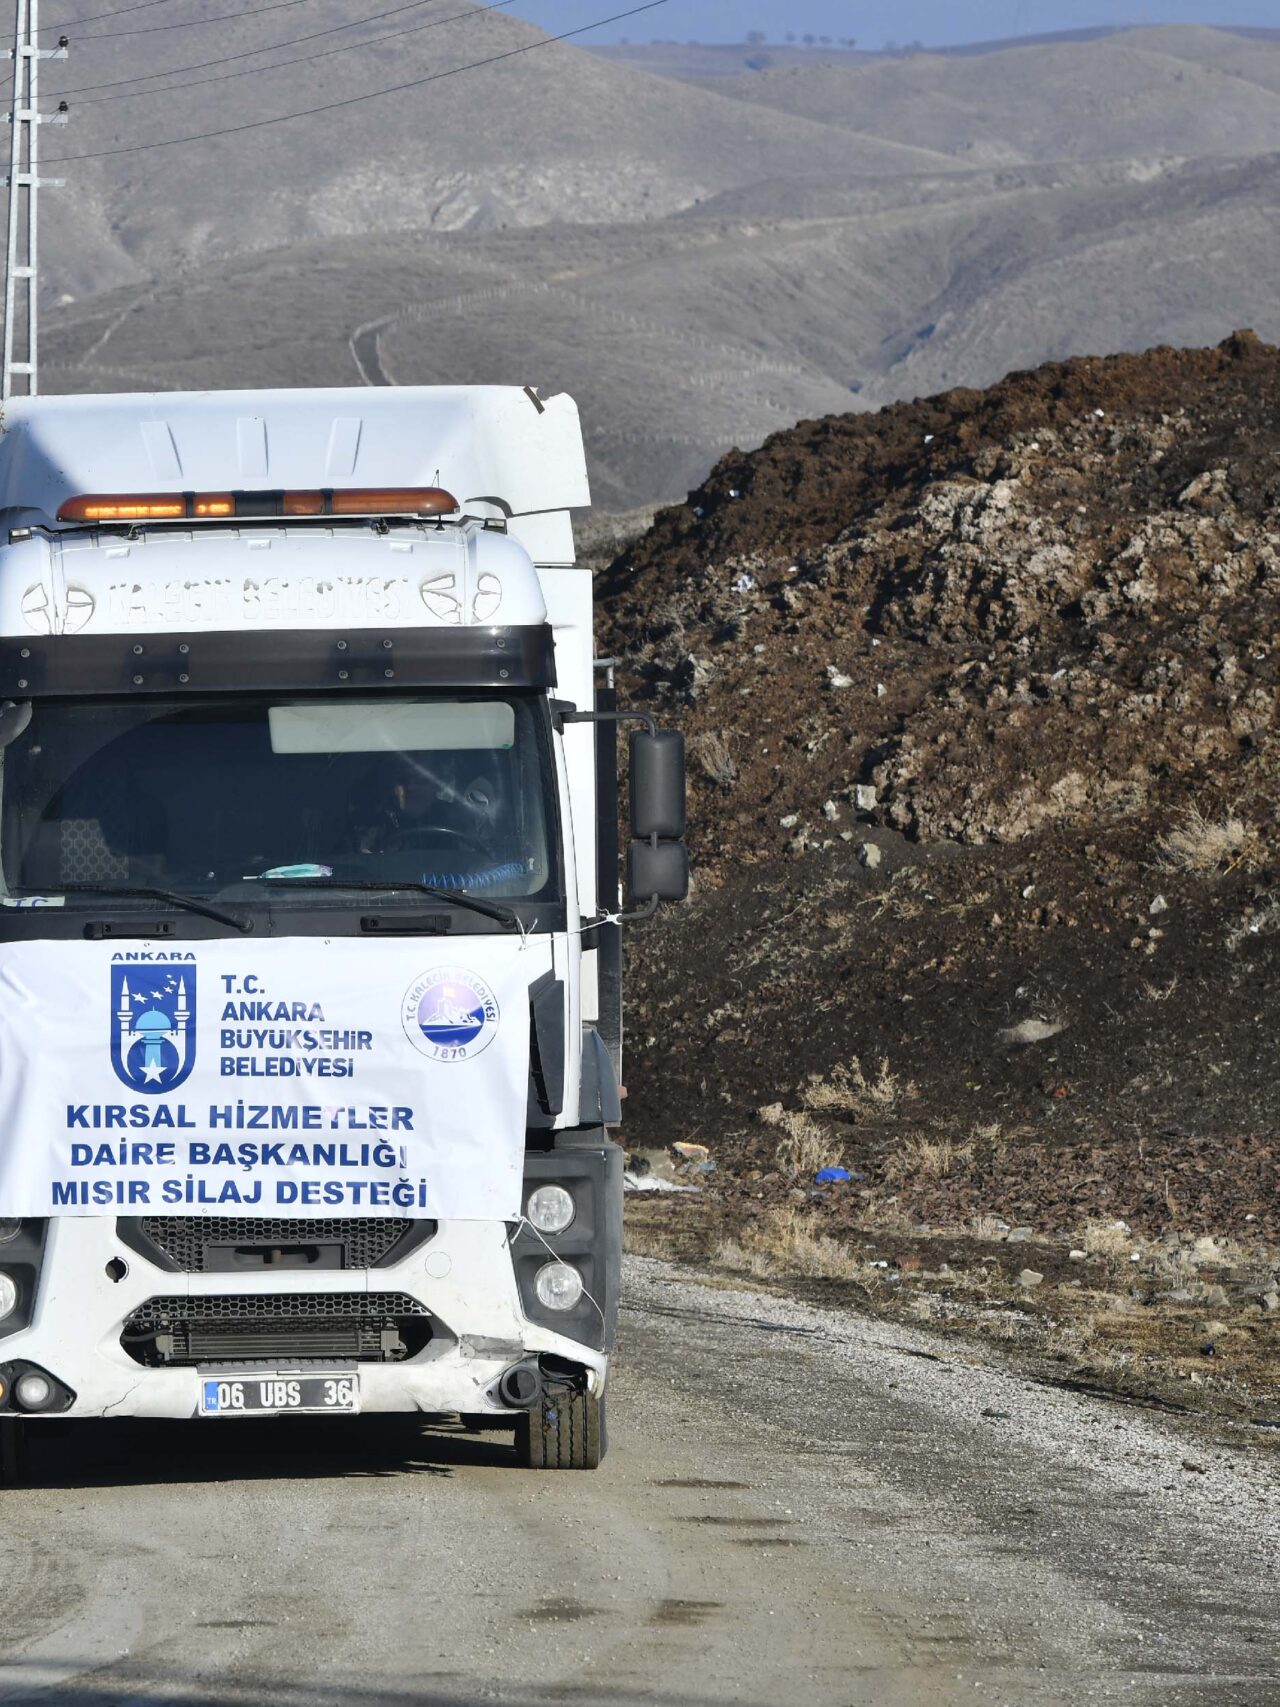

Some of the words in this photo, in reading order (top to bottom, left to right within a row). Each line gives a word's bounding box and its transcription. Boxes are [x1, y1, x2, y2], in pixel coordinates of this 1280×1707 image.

[111, 952, 196, 961] ANKARA
[221, 974, 265, 994] T.C.
[221, 1001, 325, 1022] ANKARA
[220, 1029, 373, 1052] BÜYÜKŞEHİR
[433, 1046, 467, 1060] 1870
[220, 1056, 354, 1078] BELEDİYESİ
[67, 1104, 196, 1128] KIRSAL
[209, 1099, 414, 1130] HİZMETLER
[71, 1137, 175, 1166] DAİRE
[189, 1138, 408, 1172] BAŞKANLIĞI
[52, 1180, 151, 1205] MISIR
[162, 1174, 262, 1204] SİLAJ
[276, 1177, 427, 1208] DESTEĞİ
[218, 1383, 244, 1409] 06
[260, 1381, 301, 1407] UBS
[324, 1380, 351, 1405] 36
